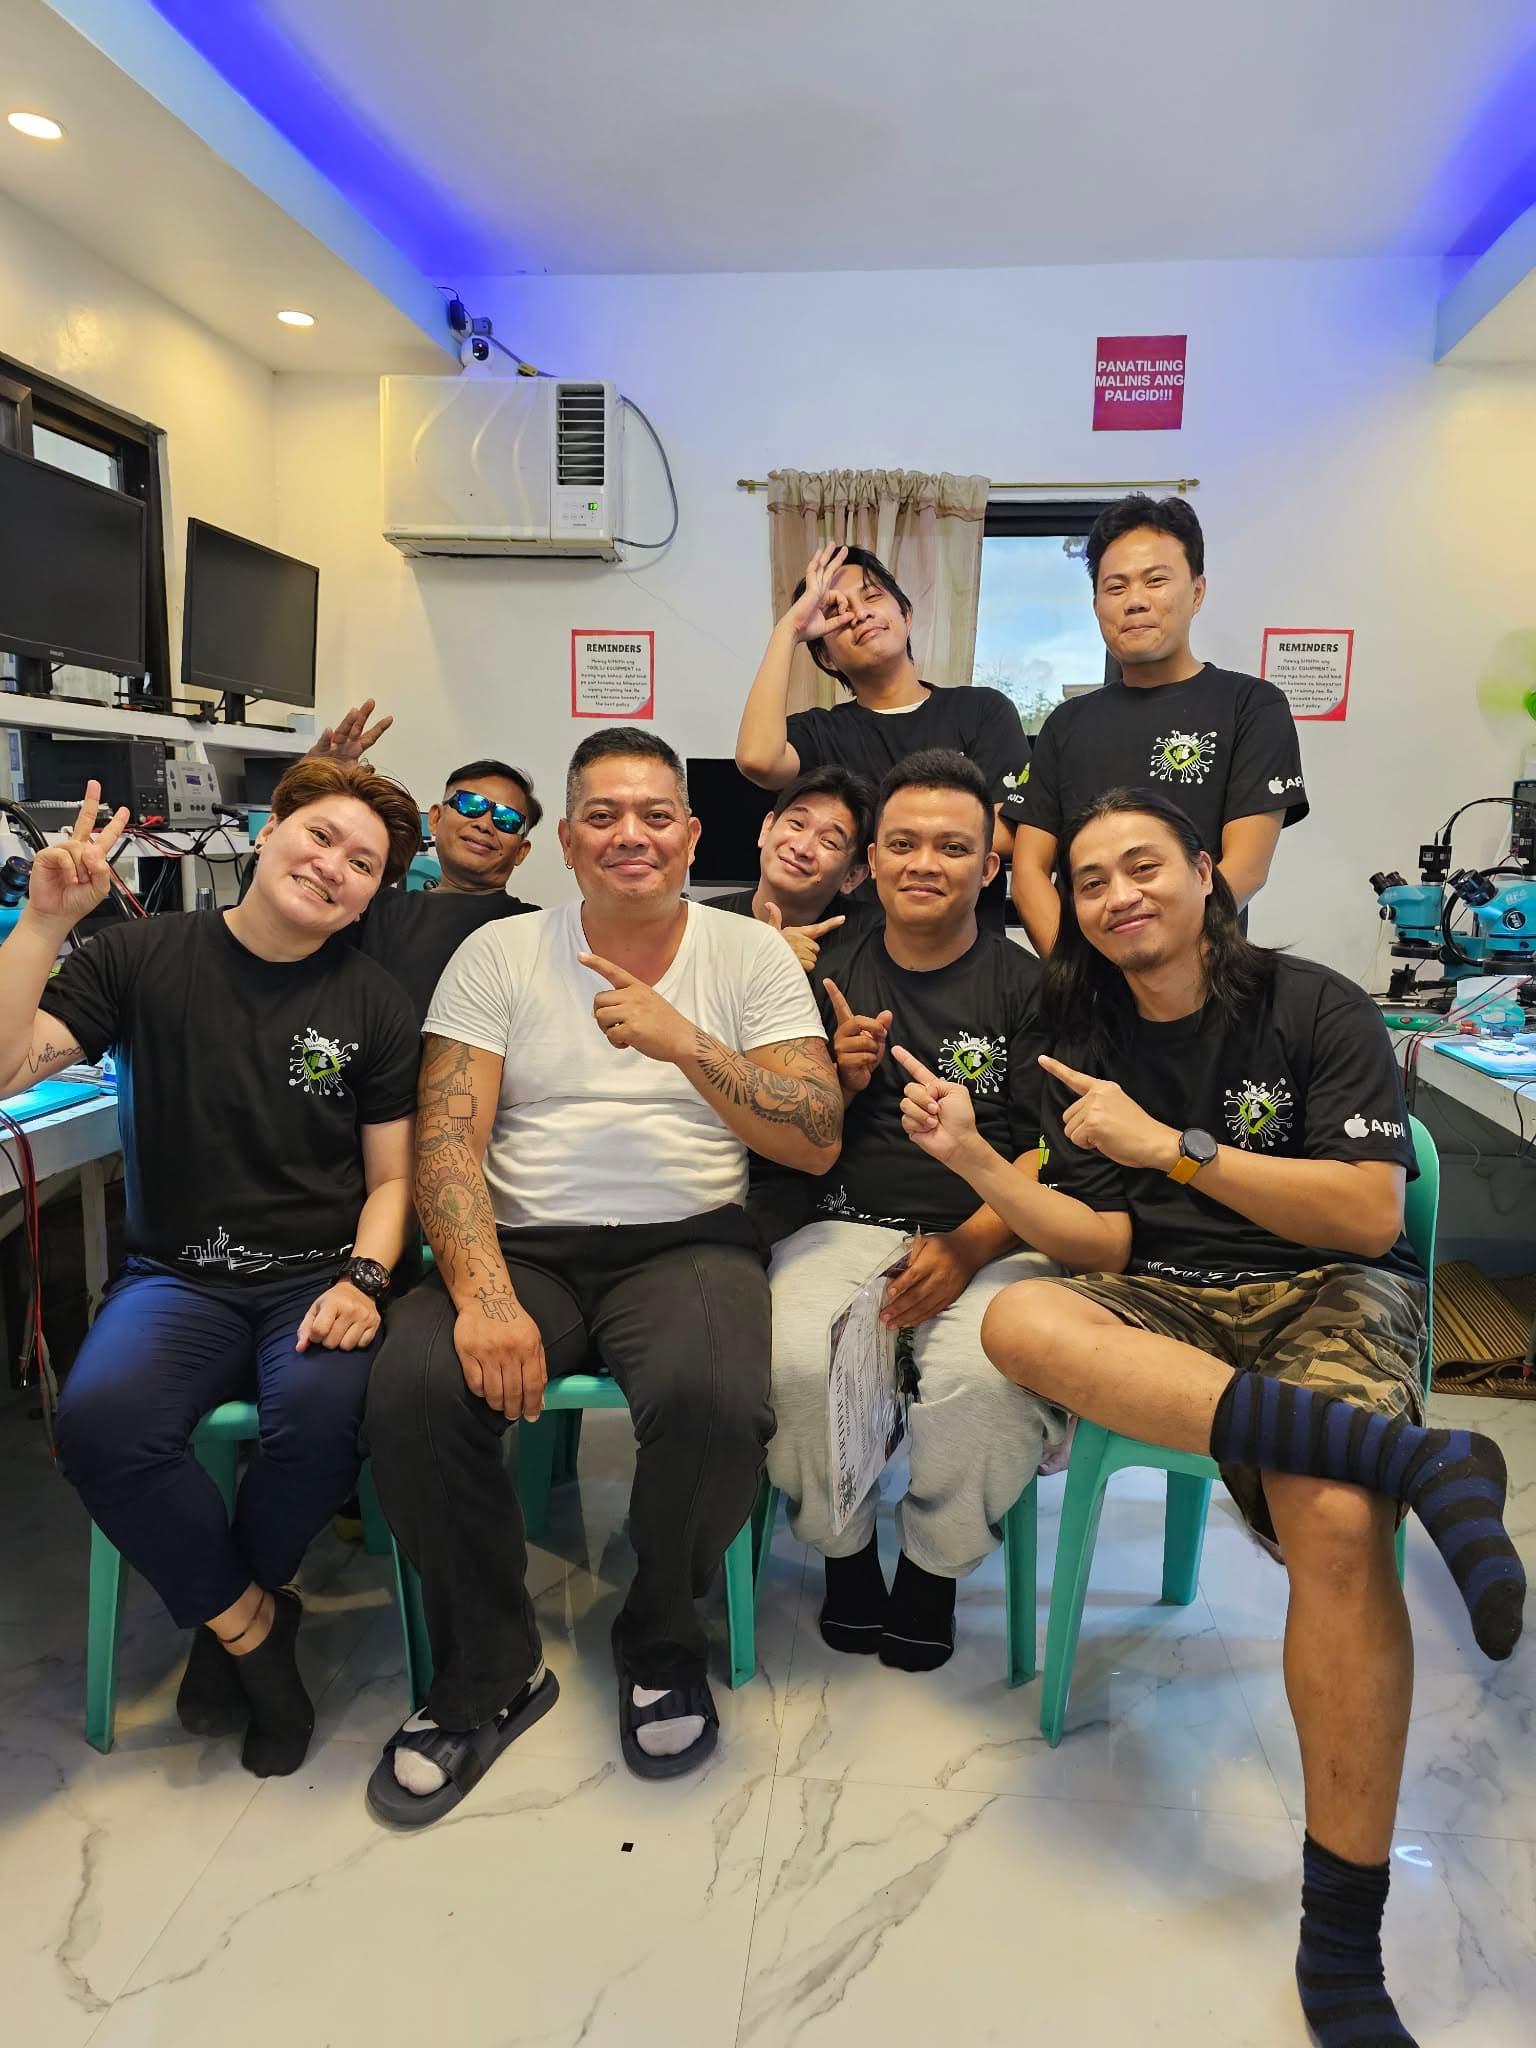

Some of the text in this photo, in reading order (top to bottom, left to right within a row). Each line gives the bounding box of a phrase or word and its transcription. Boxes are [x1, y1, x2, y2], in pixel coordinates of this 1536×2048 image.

[1097, 360, 1183, 372] PANATILIING
[1096, 375, 1184, 386] MALINIS ANG
[1105, 389, 1172, 402] PALIGID!!!
[586, 643, 642, 653] REMINDERS
[1279, 643, 1339, 652] REMINDERS
